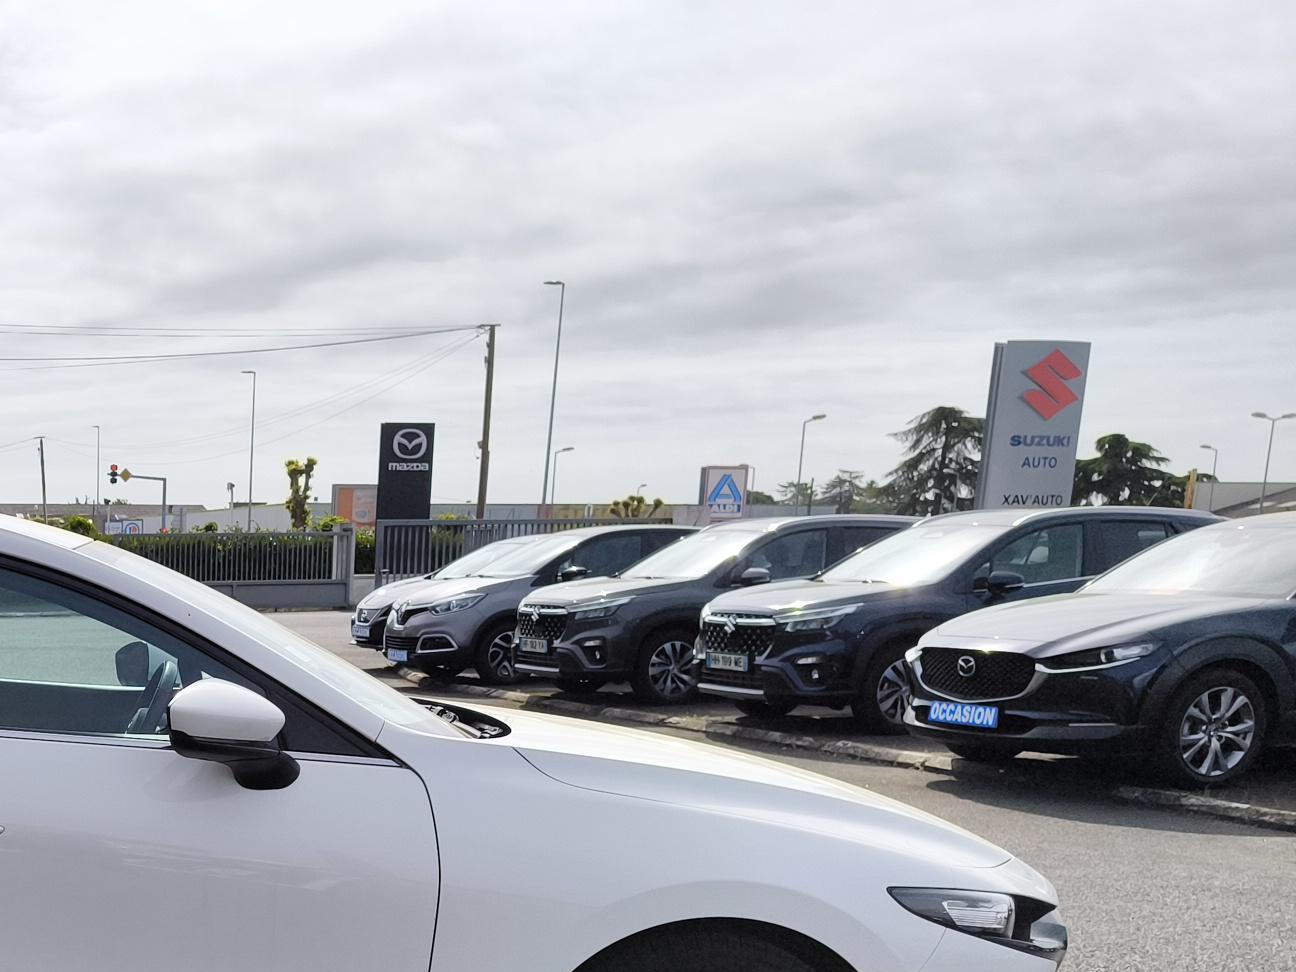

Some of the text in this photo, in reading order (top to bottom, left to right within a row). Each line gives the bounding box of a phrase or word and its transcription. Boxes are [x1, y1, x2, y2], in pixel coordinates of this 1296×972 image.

[1009, 434, 1071, 447] SUZUKI
[1021, 456, 1057, 468] AUTO
[710, 503, 738, 512] ALDI
[930, 702, 996, 725] OCCASION
